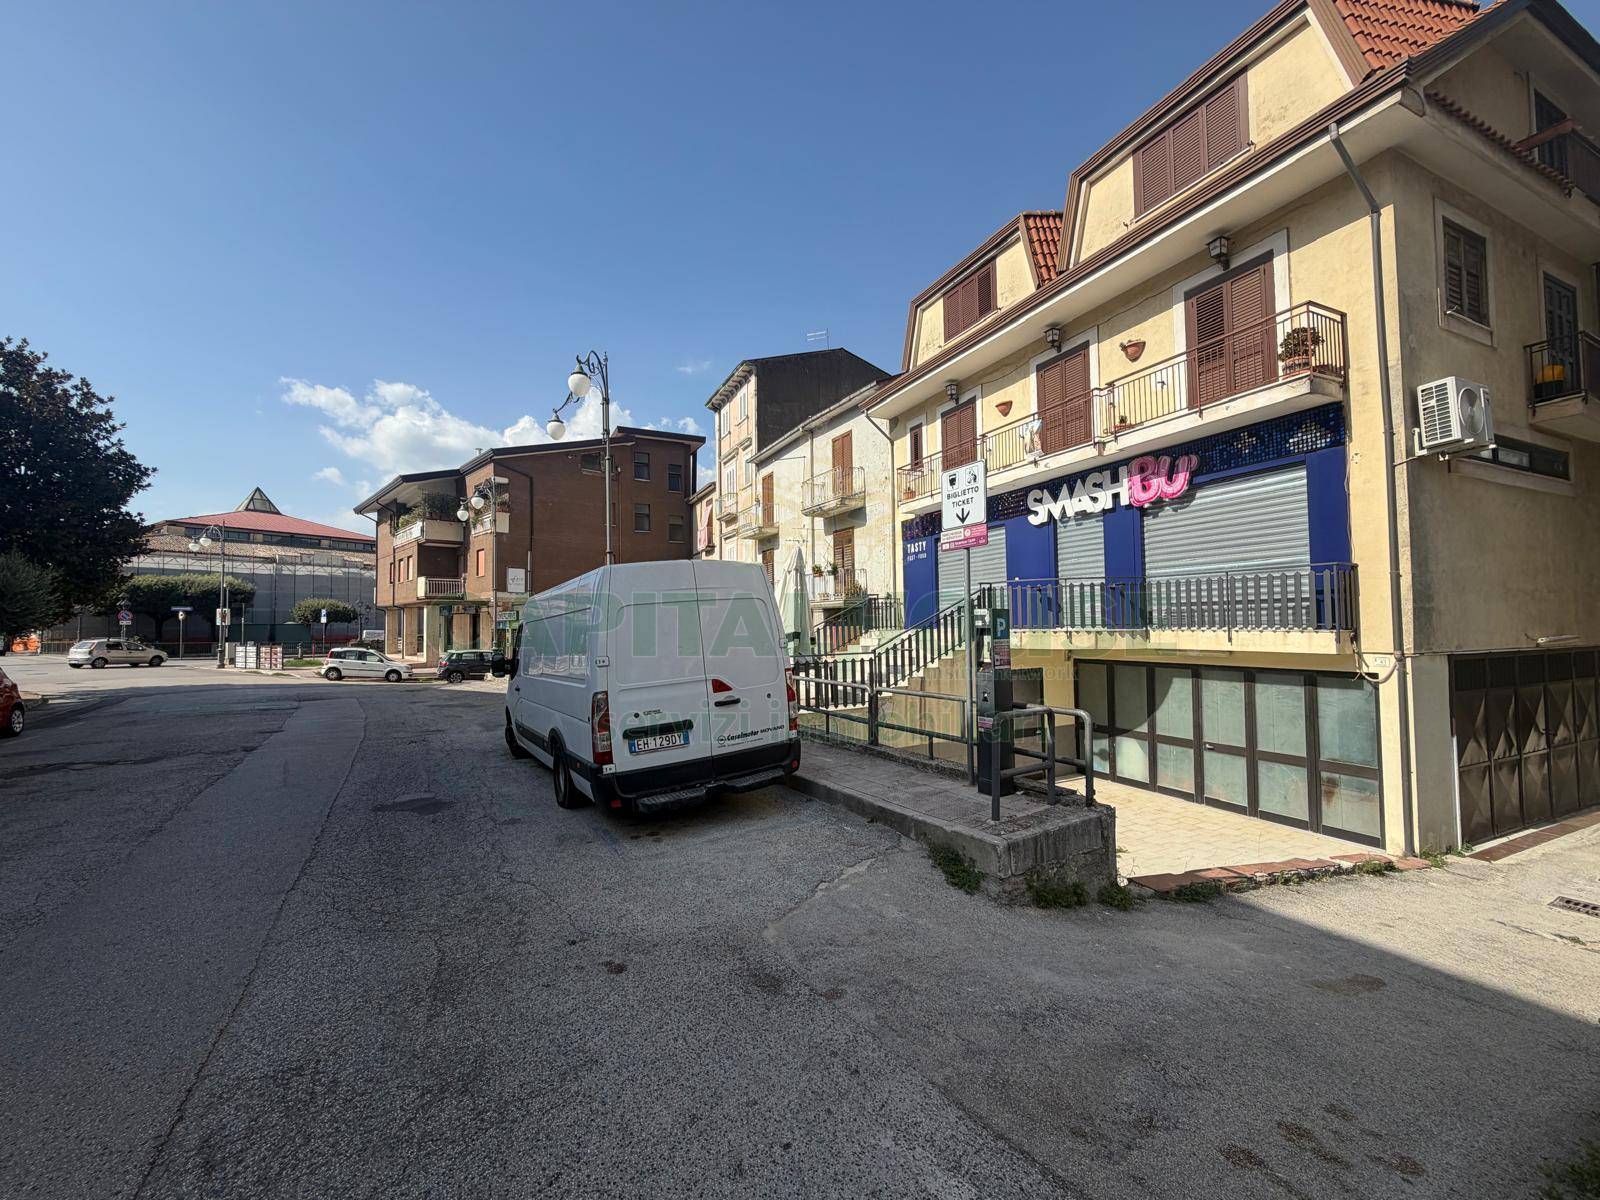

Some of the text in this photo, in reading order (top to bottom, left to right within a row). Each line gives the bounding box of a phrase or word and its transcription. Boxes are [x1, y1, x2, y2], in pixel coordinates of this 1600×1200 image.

[946, 485, 980, 500] BIGLIETTO
[952, 496, 975, 508] TICKET
[906, 540, 927, 554] TASTY
[637, 732, 683, 751] EH 129DY
